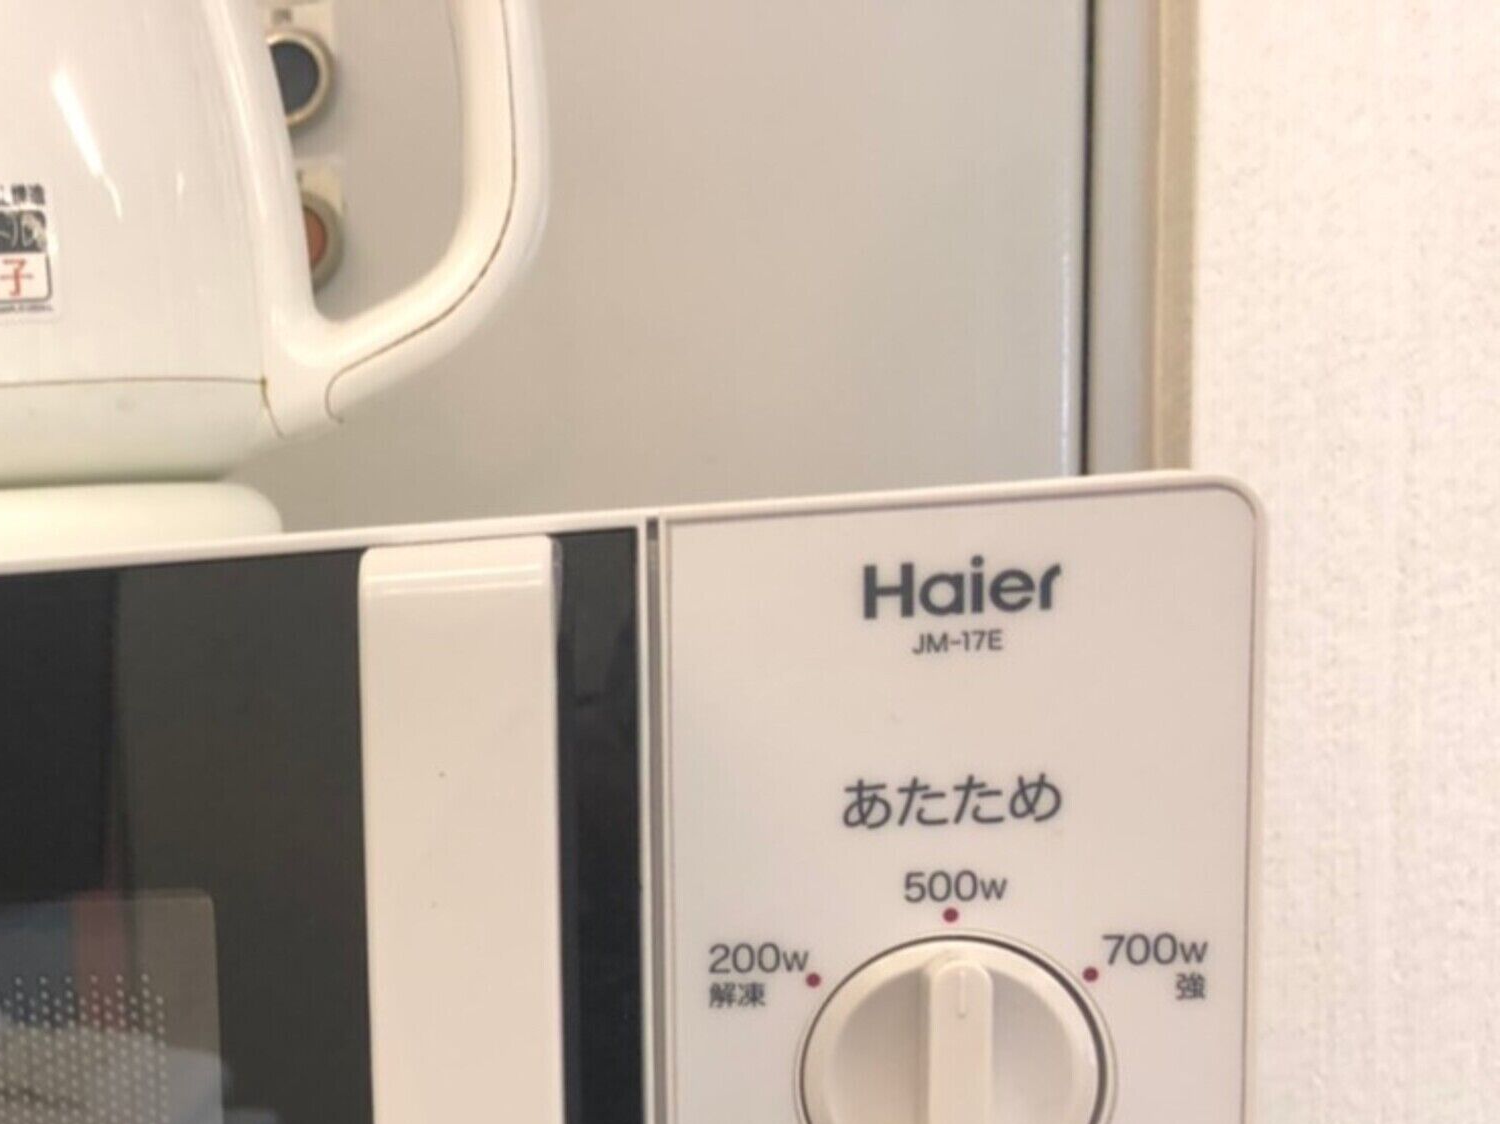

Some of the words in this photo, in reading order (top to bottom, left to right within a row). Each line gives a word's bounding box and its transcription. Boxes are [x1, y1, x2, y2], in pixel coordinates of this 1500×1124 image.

[863, 555, 1062, 620] Haier
[912, 629, 1003, 655] JM-17E
[842, 773, 1062, 830] あたため
[709, 982, 765, 1008] 解凍
[1176, 972, 1205, 1000] 強
